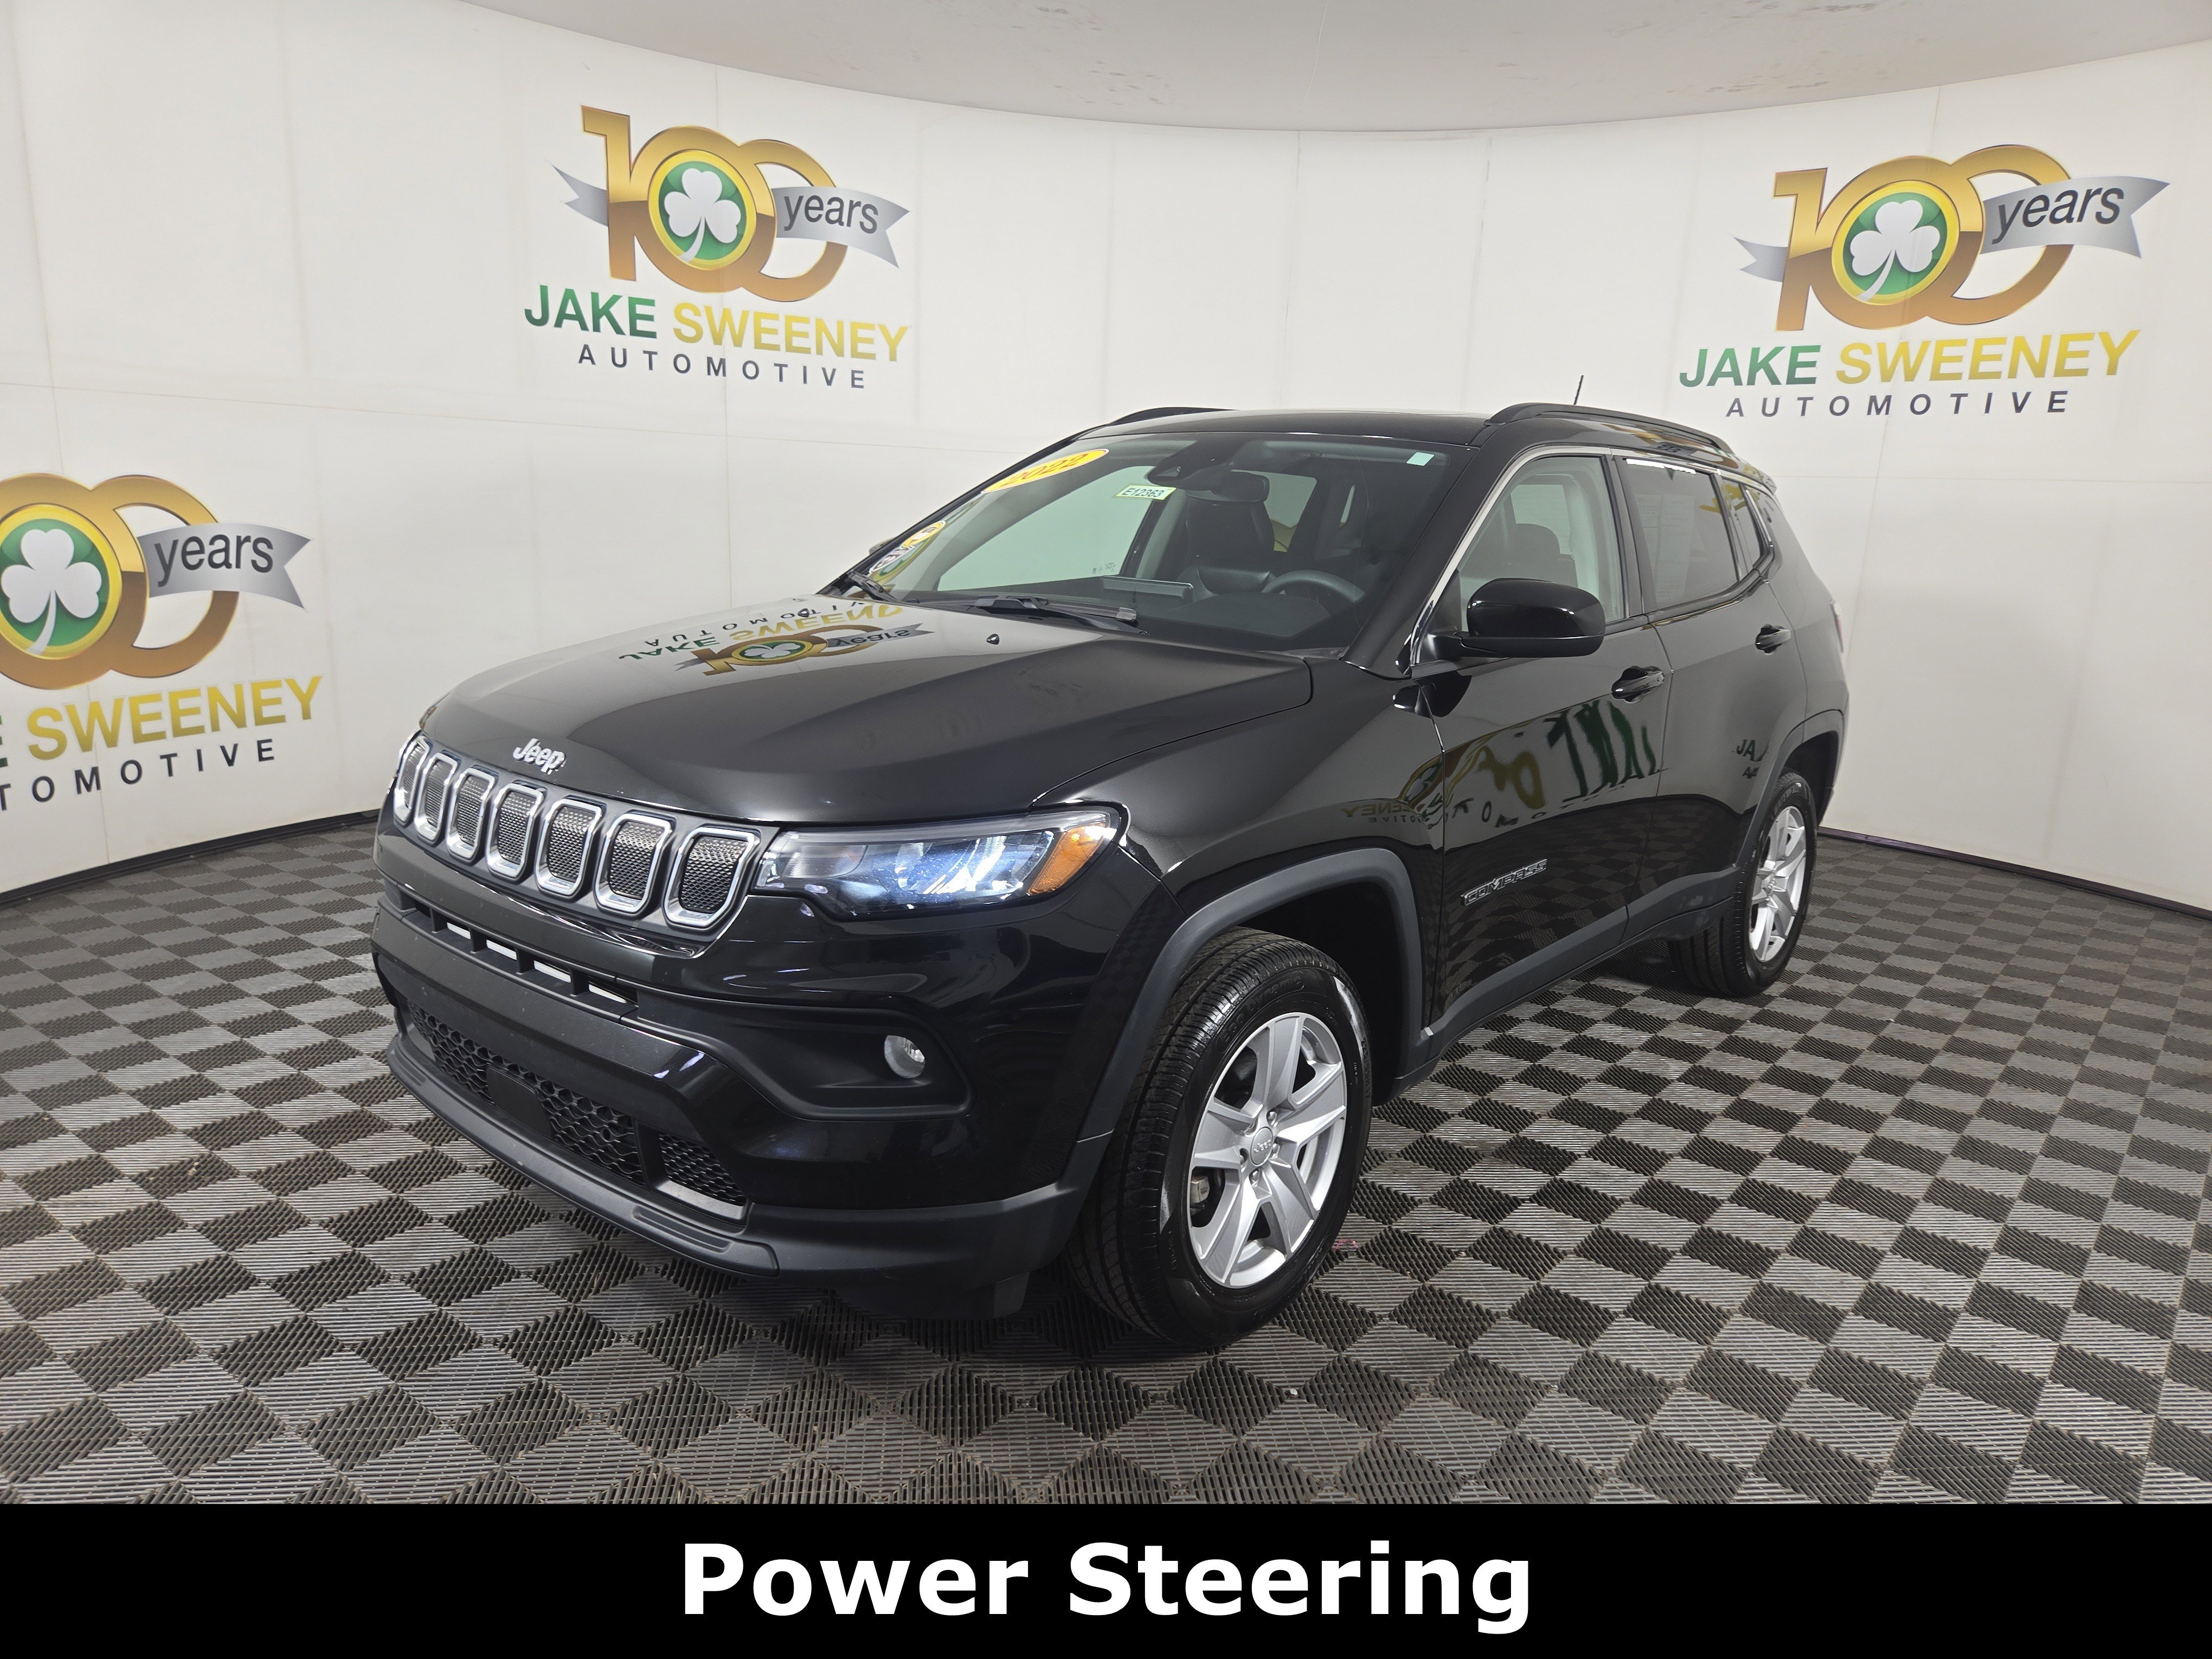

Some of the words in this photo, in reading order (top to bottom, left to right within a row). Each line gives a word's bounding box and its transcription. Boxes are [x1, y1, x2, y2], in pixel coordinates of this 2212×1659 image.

[783, 194, 880, 235] years
[1991, 185, 2125, 243] years
[524, 284, 658, 339] JAKE
[672, 301, 910, 363] SWEENEY
[577, 343, 865, 389] AUTOMOTIVE
[1679, 344, 1822, 389] JAKE
[1836, 330, 2142, 384] SWEENEY
[1726, 390, 2069, 418] AUTOMOTIVE
[998, 453, 1089, 488] 2022
[1122, 487, 1165, 498] E12363
[153, 534, 274, 587] years
[27, 675, 323, 761] SWEENEY
[513, 738, 566, 774] Jeep
[1462, 859, 1548, 906] COMPASS
